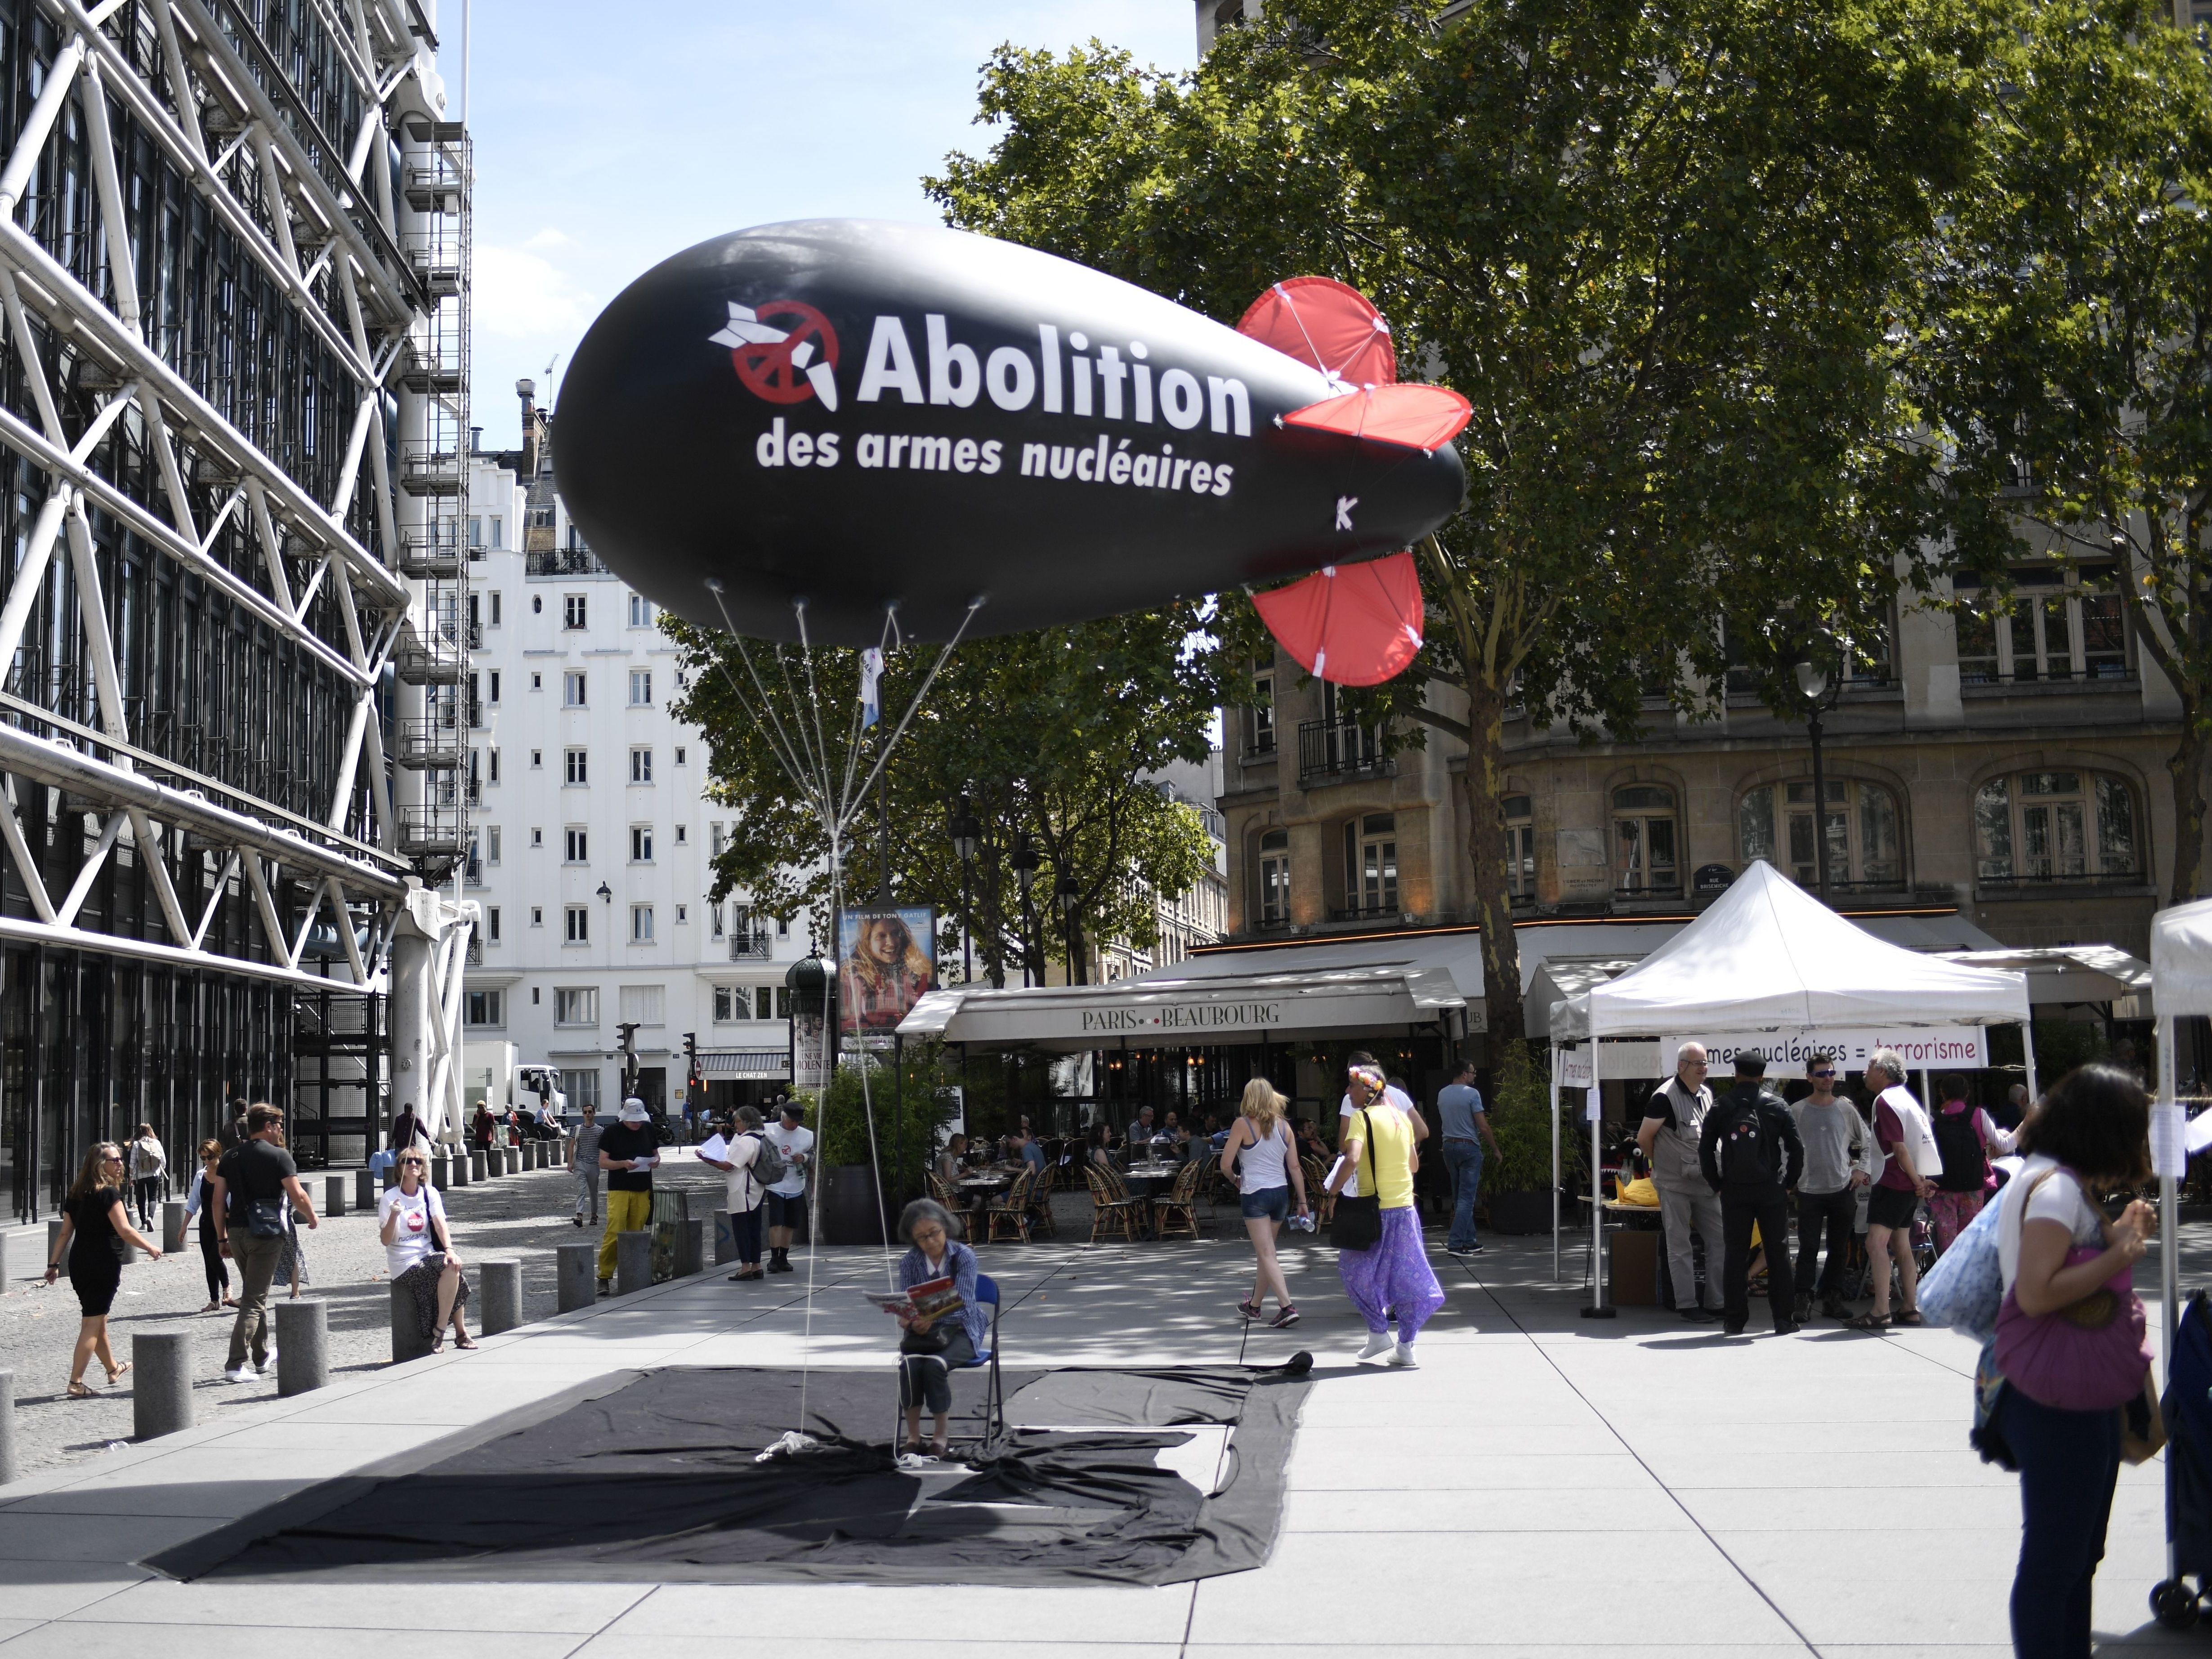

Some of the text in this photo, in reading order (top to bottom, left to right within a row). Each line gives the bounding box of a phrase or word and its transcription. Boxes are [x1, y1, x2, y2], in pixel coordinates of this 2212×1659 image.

[857, 313, 1251, 437] Abolition
[756, 417, 1233, 496] des armes nucléaires
[1081, 1003, 1280, 1030] PARIS BEAUBOURG
[795, 1060, 830, 1070] VIOLENTE
[408, 1218, 423, 1226] STOP
